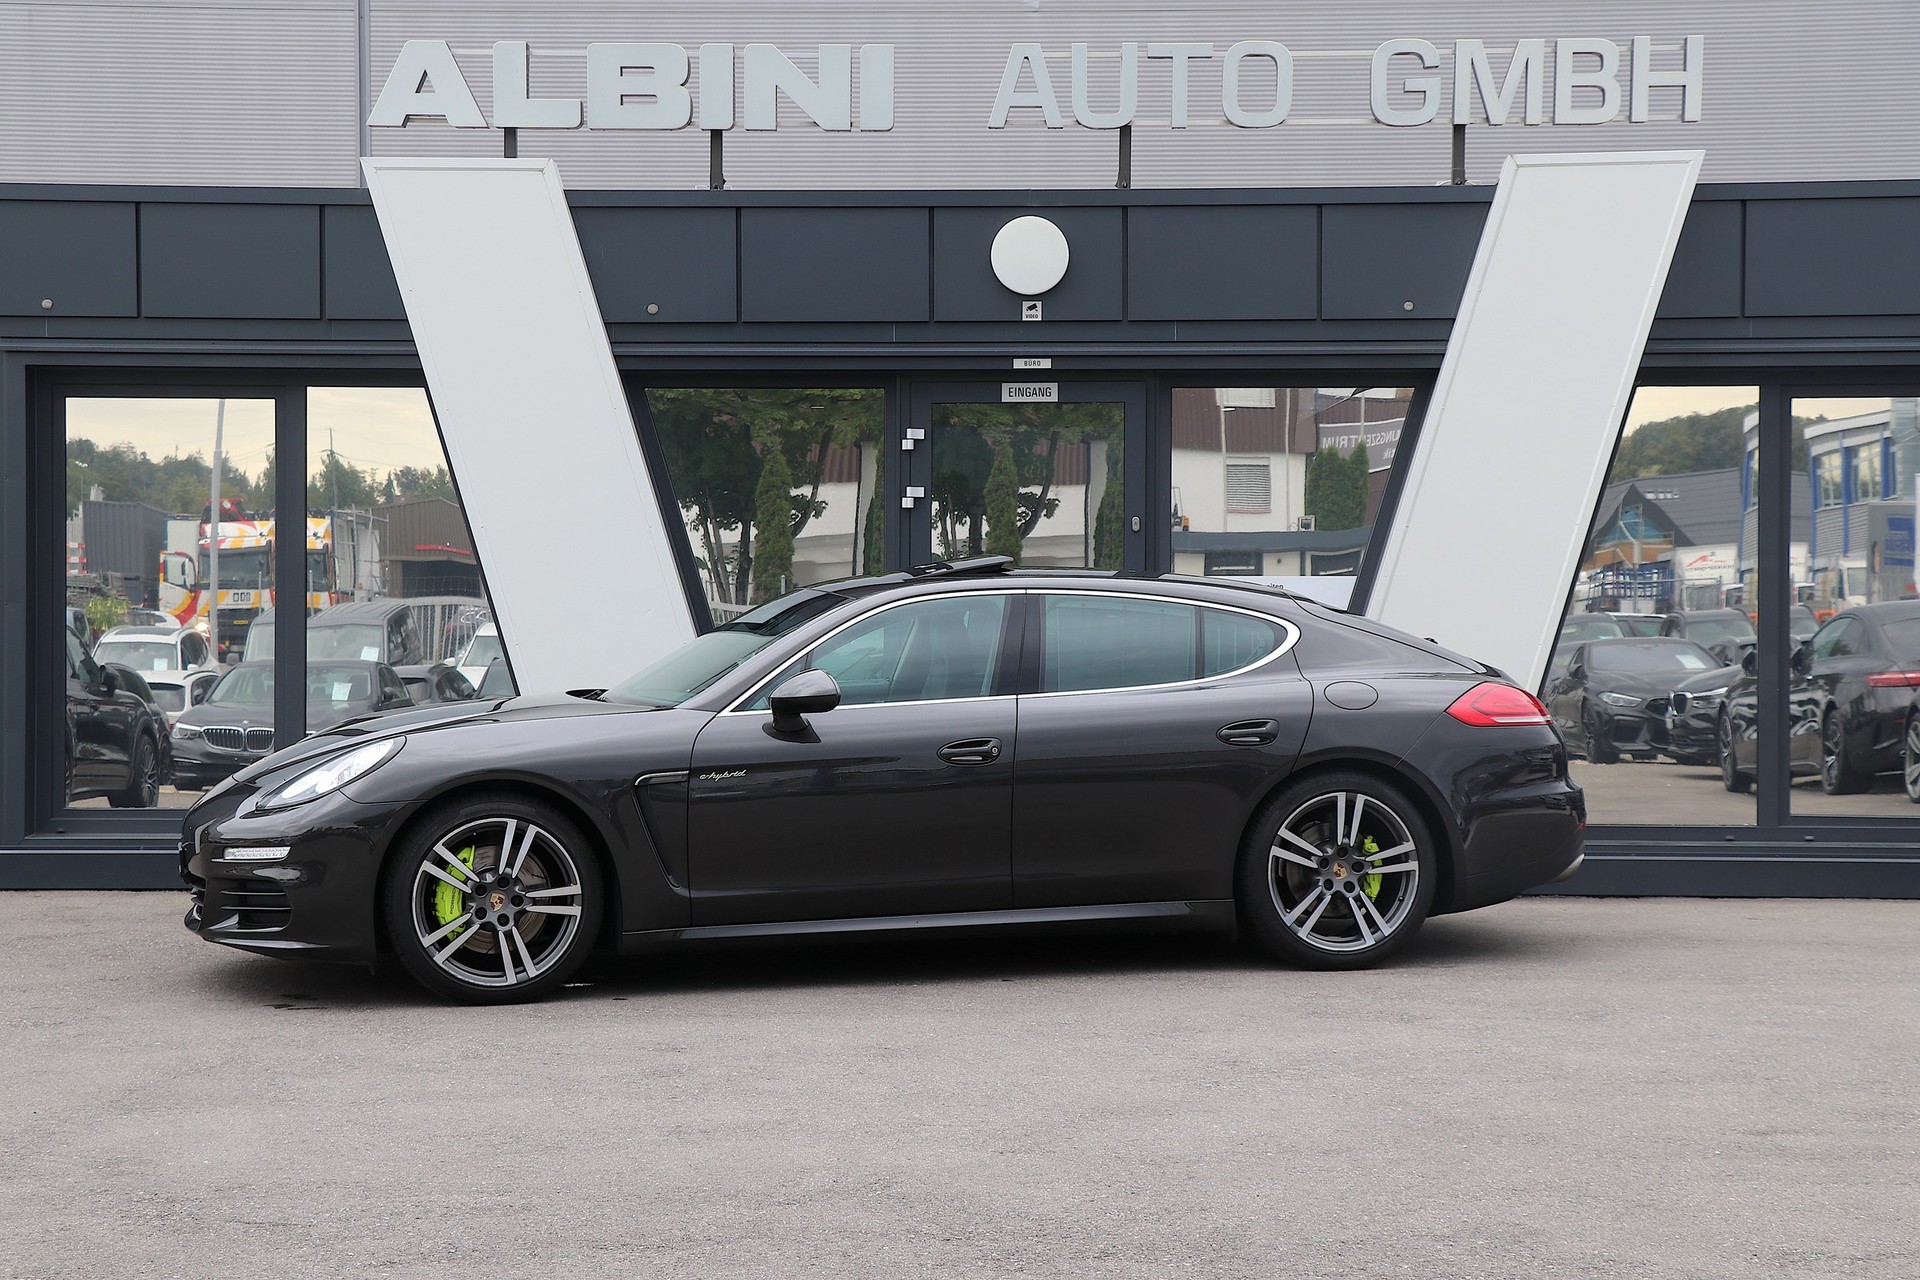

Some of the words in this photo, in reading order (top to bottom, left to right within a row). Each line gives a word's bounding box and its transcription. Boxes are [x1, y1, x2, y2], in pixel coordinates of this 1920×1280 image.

[366, 40, 896, 132] ALBINI
[987, 40, 1294, 130] AUTO
[1370, 34, 1704, 127] GMBH
[1008, 387, 1052, 397] EINGANG
